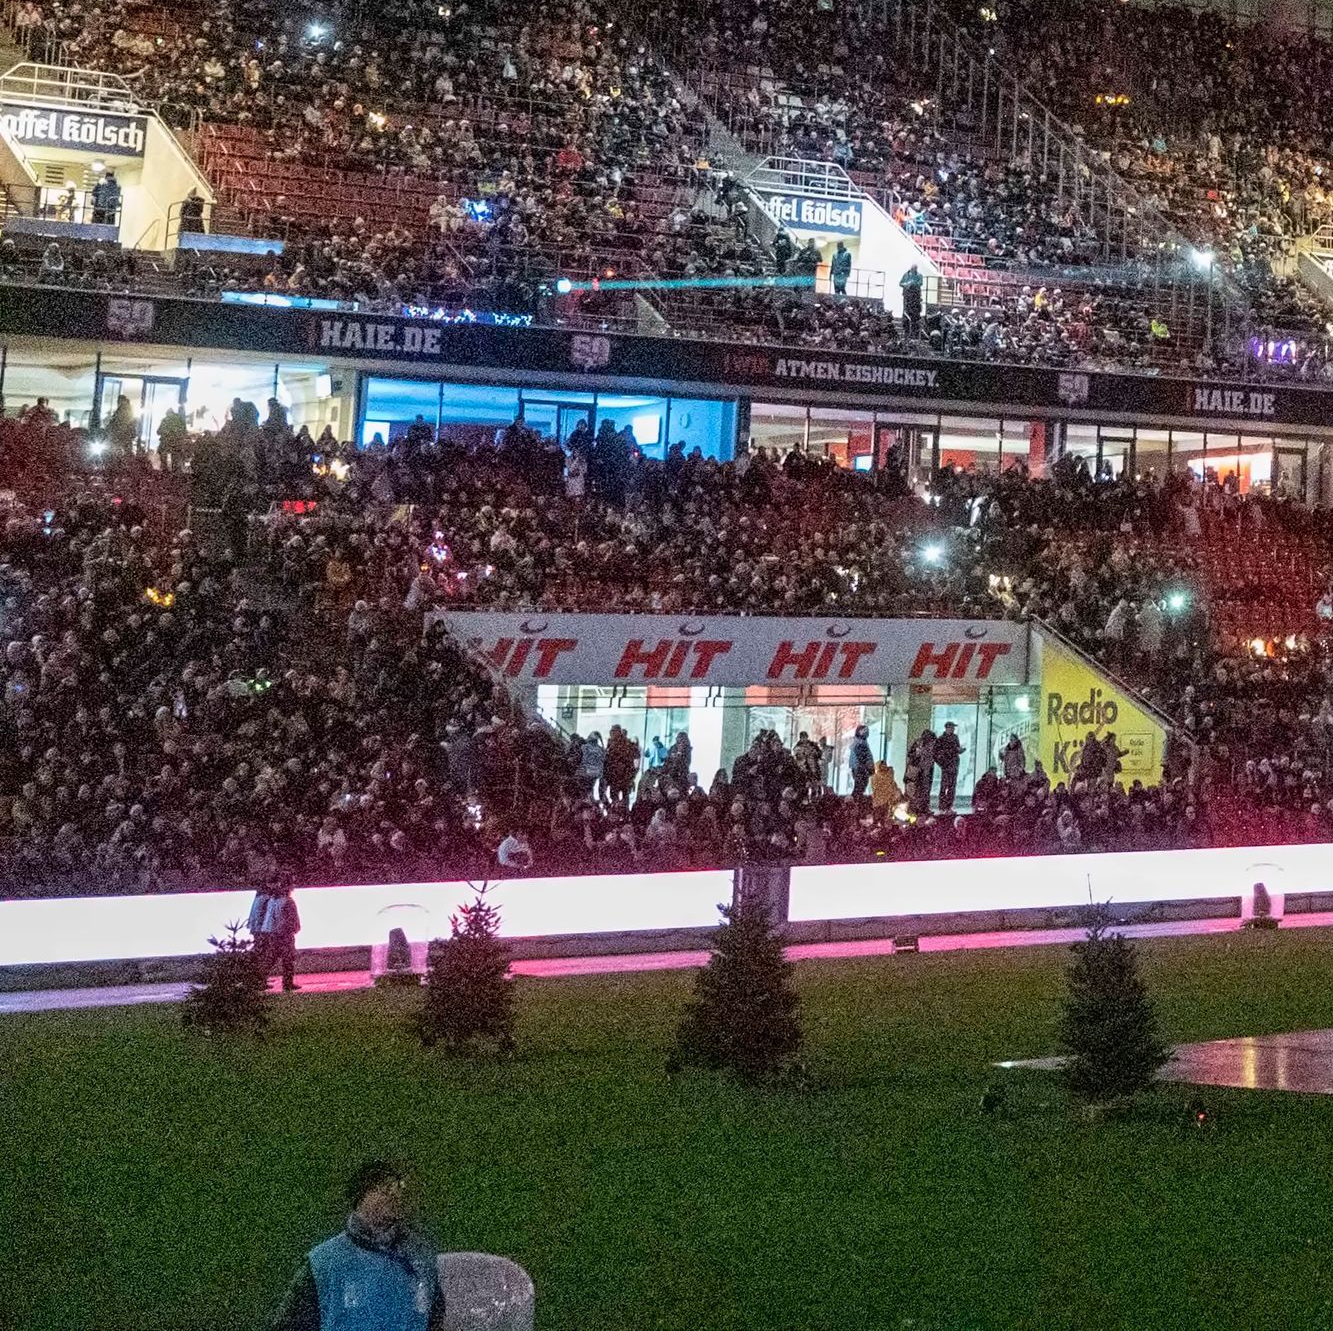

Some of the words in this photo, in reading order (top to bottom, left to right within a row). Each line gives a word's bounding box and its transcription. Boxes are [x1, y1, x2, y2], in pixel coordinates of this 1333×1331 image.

[0, 108, 59, 140] affel
[61, 114, 145, 152] Kölsch
[801, 200, 861, 232] Kölsch
[320, 320, 442, 354] HAIE.DE
[1194, 389, 1276, 415] HAIE.DE
[613, 638, 734, 679] HIT
[766, 640, 878, 679] HIT
[908, 642, 1013, 679] HIT
[1047, 688, 1118, 726] Radio
